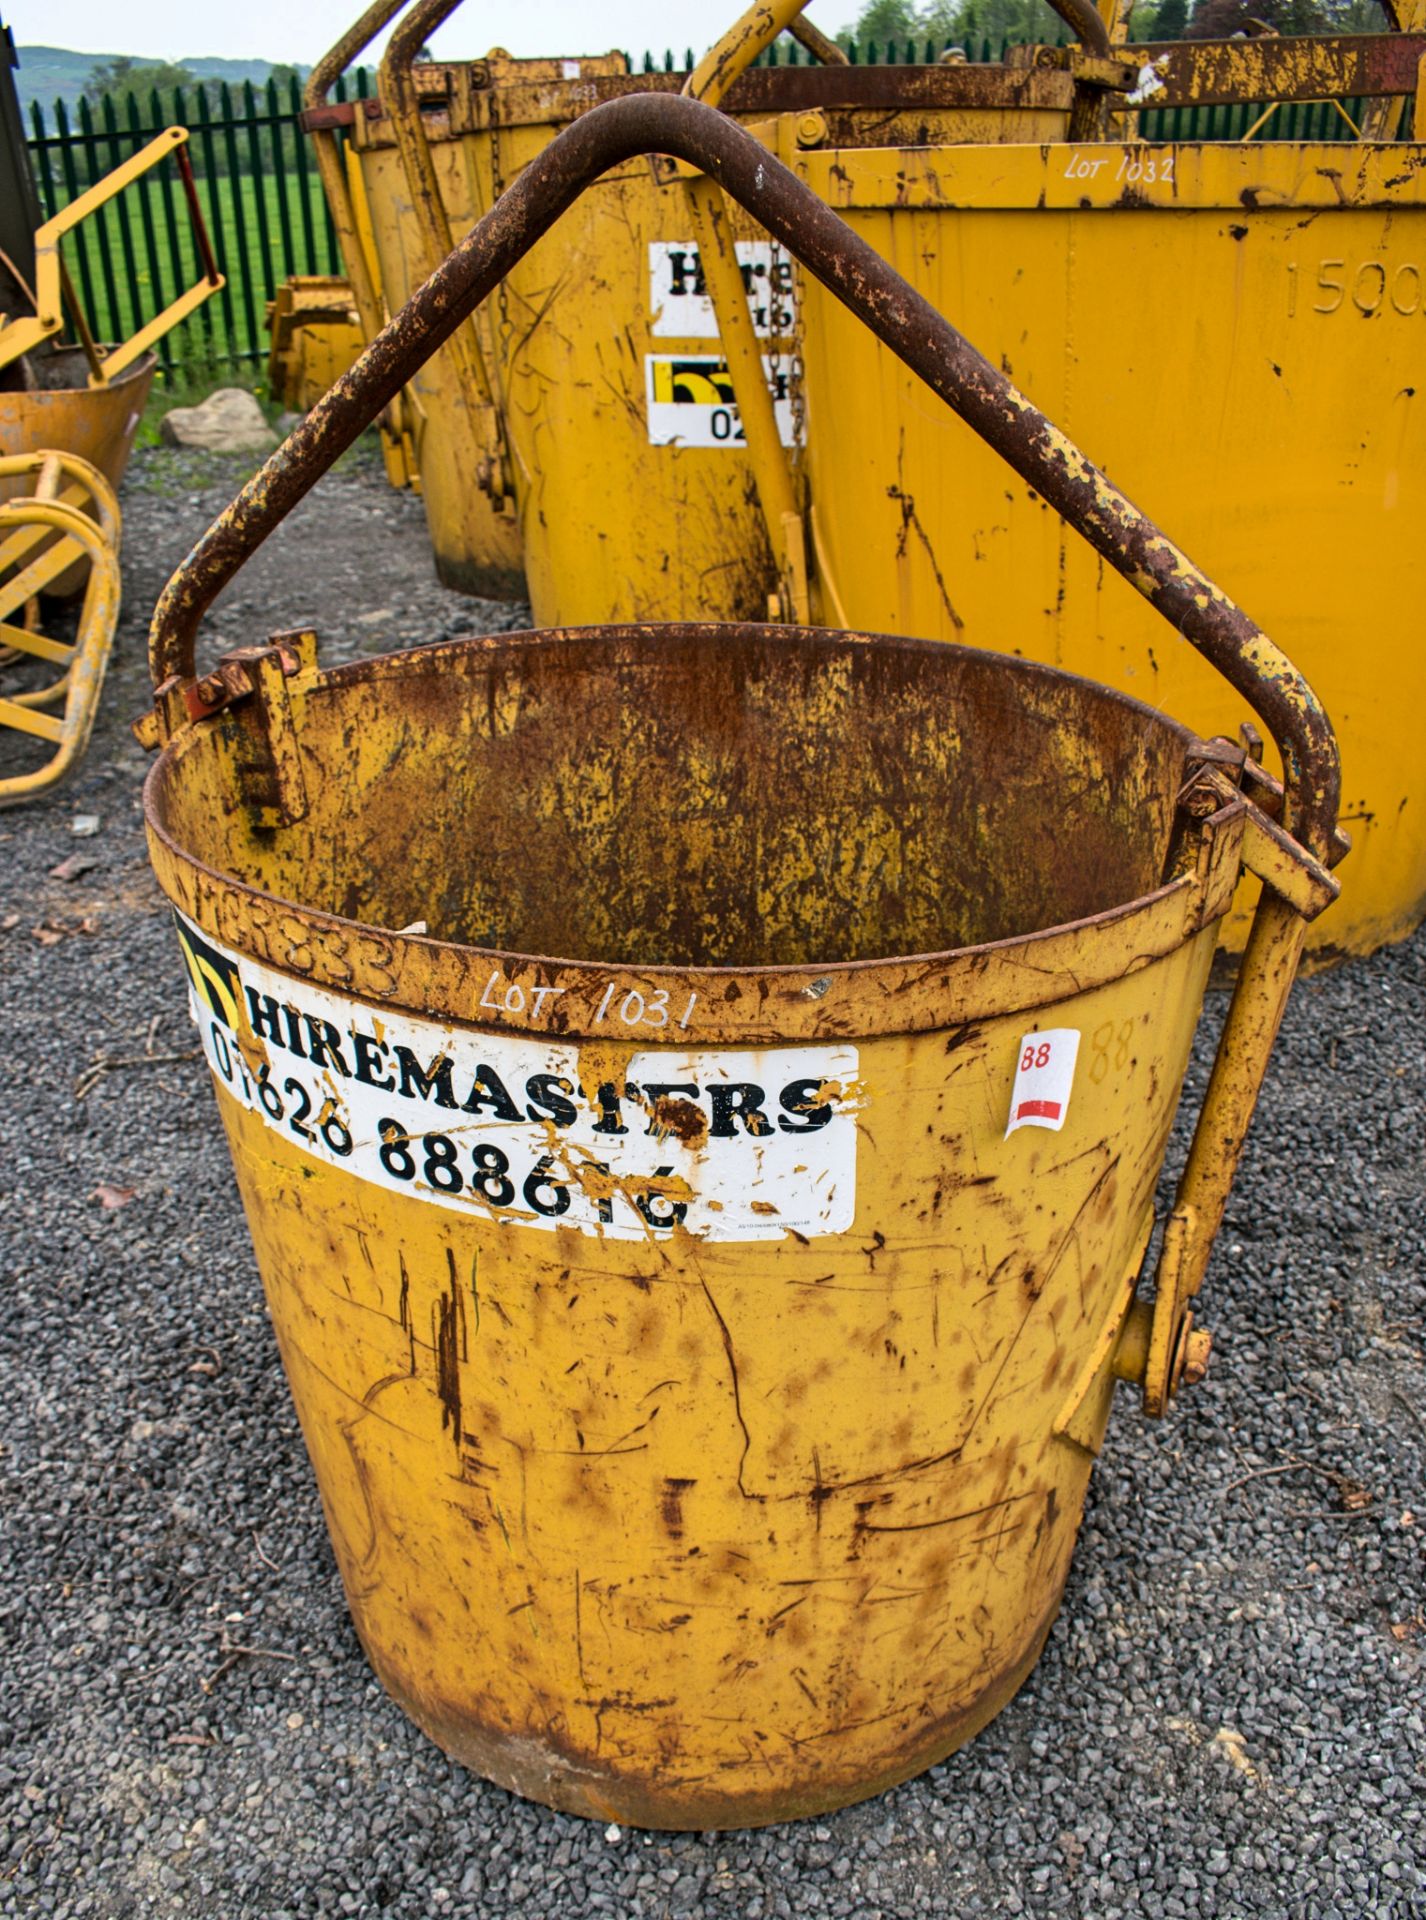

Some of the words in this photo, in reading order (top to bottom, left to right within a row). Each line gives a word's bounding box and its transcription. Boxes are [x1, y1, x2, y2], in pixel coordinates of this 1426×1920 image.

[1064, 153, 1109, 179] LOT
[1115, 155, 1175, 183] 1032
[479, 970, 566, 1019] LOT
[596, 982, 698, 1030] 1031
[244, 984, 835, 1138] HIREMASTERS
[1020, 1042, 1052, 1073] 88
